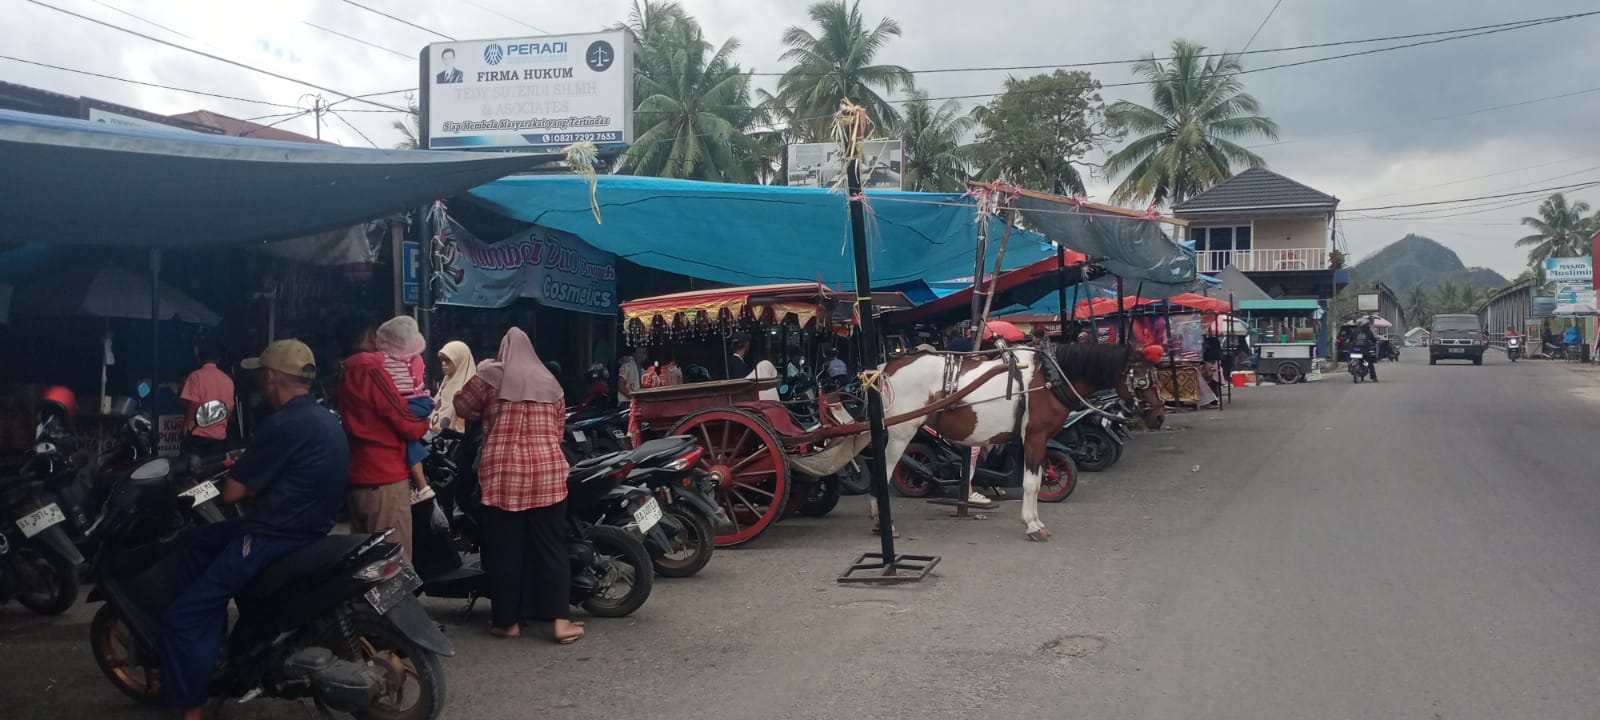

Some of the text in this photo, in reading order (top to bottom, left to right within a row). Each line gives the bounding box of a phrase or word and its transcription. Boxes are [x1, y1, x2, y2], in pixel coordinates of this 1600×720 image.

[507, 42, 567, 55] PERADI
[477, 67, 573, 82] FIRMA HUKUM
[443, 115, 610, 133] Siap Membela Masyarakat yang Tertindas
[554, 134, 573, 142] 0821
[543, 275, 612, 307] Cosmetics
